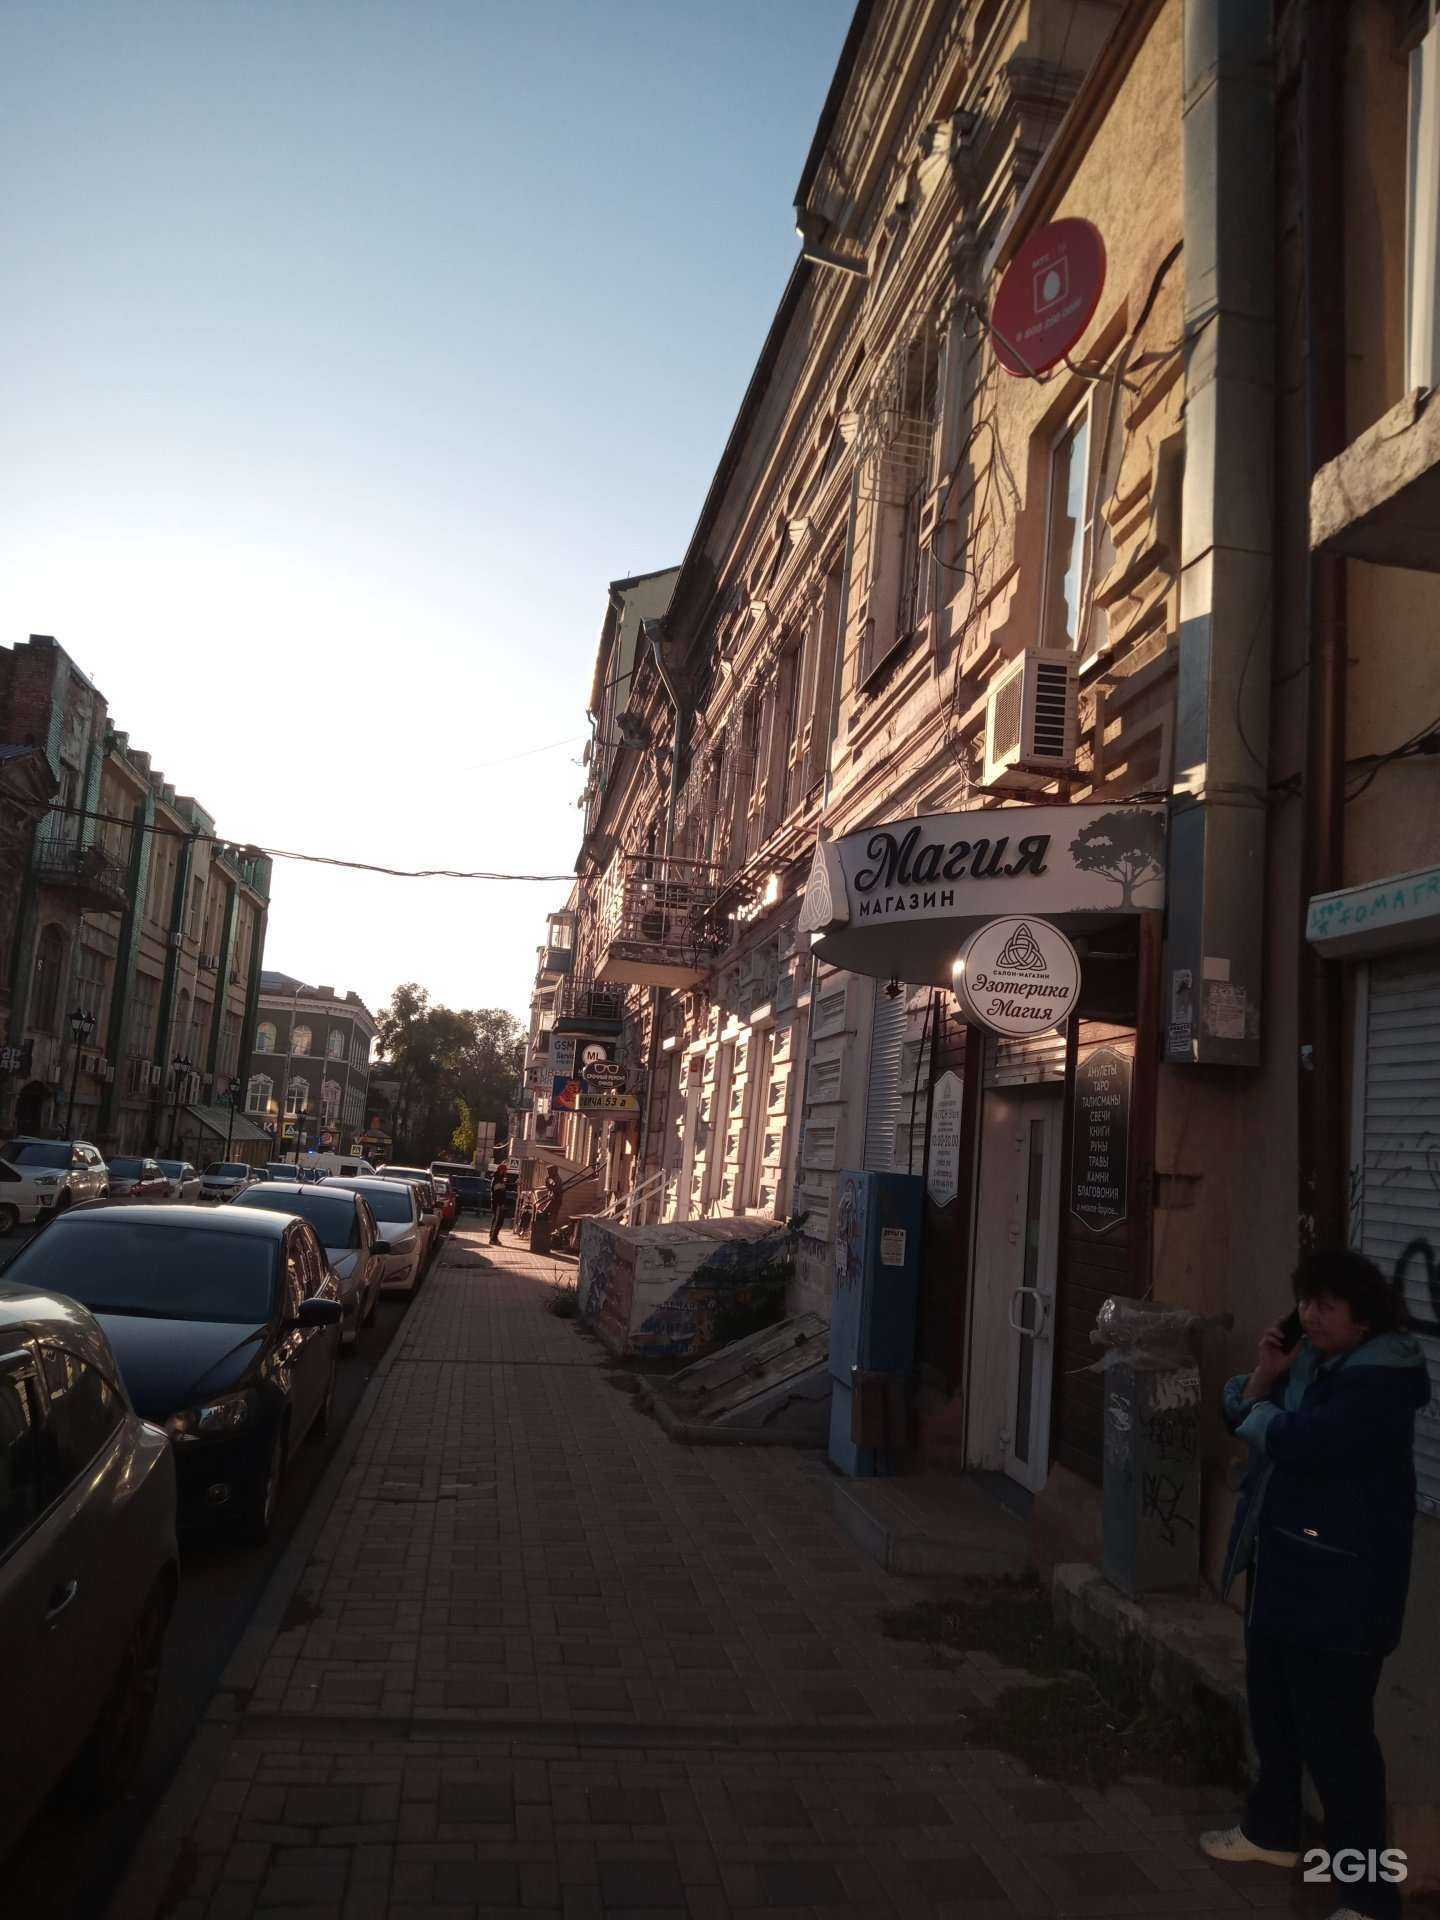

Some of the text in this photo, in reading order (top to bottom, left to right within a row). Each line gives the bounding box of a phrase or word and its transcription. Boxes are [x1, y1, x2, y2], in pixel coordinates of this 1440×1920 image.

[854, 826, 1051, 892] Магия
[859, 890, 954, 916] МАГАЗИН
[971, 974, 1070, 999] Эзотерика
[986, 998, 1053, 1020] Магия
[1093, 1079, 1109, 1093] ТАРО
[1081, 1093, 1121, 1109] ТАЛИСМАНЫ
[1089, 1110, 1111, 1122] СВЕЧИ
[1089, 1124, 1111, 1137] КНИГИ
[1090, 1140, 1108, 1153] РУНЫ
[1088, 1155, 1109, 1168] ТРАВЫ
[1087, 1171, 1110, 1183] КАМНИ
[1077, 1184, 1119, 1201] БЛАГОВОНИЯ
